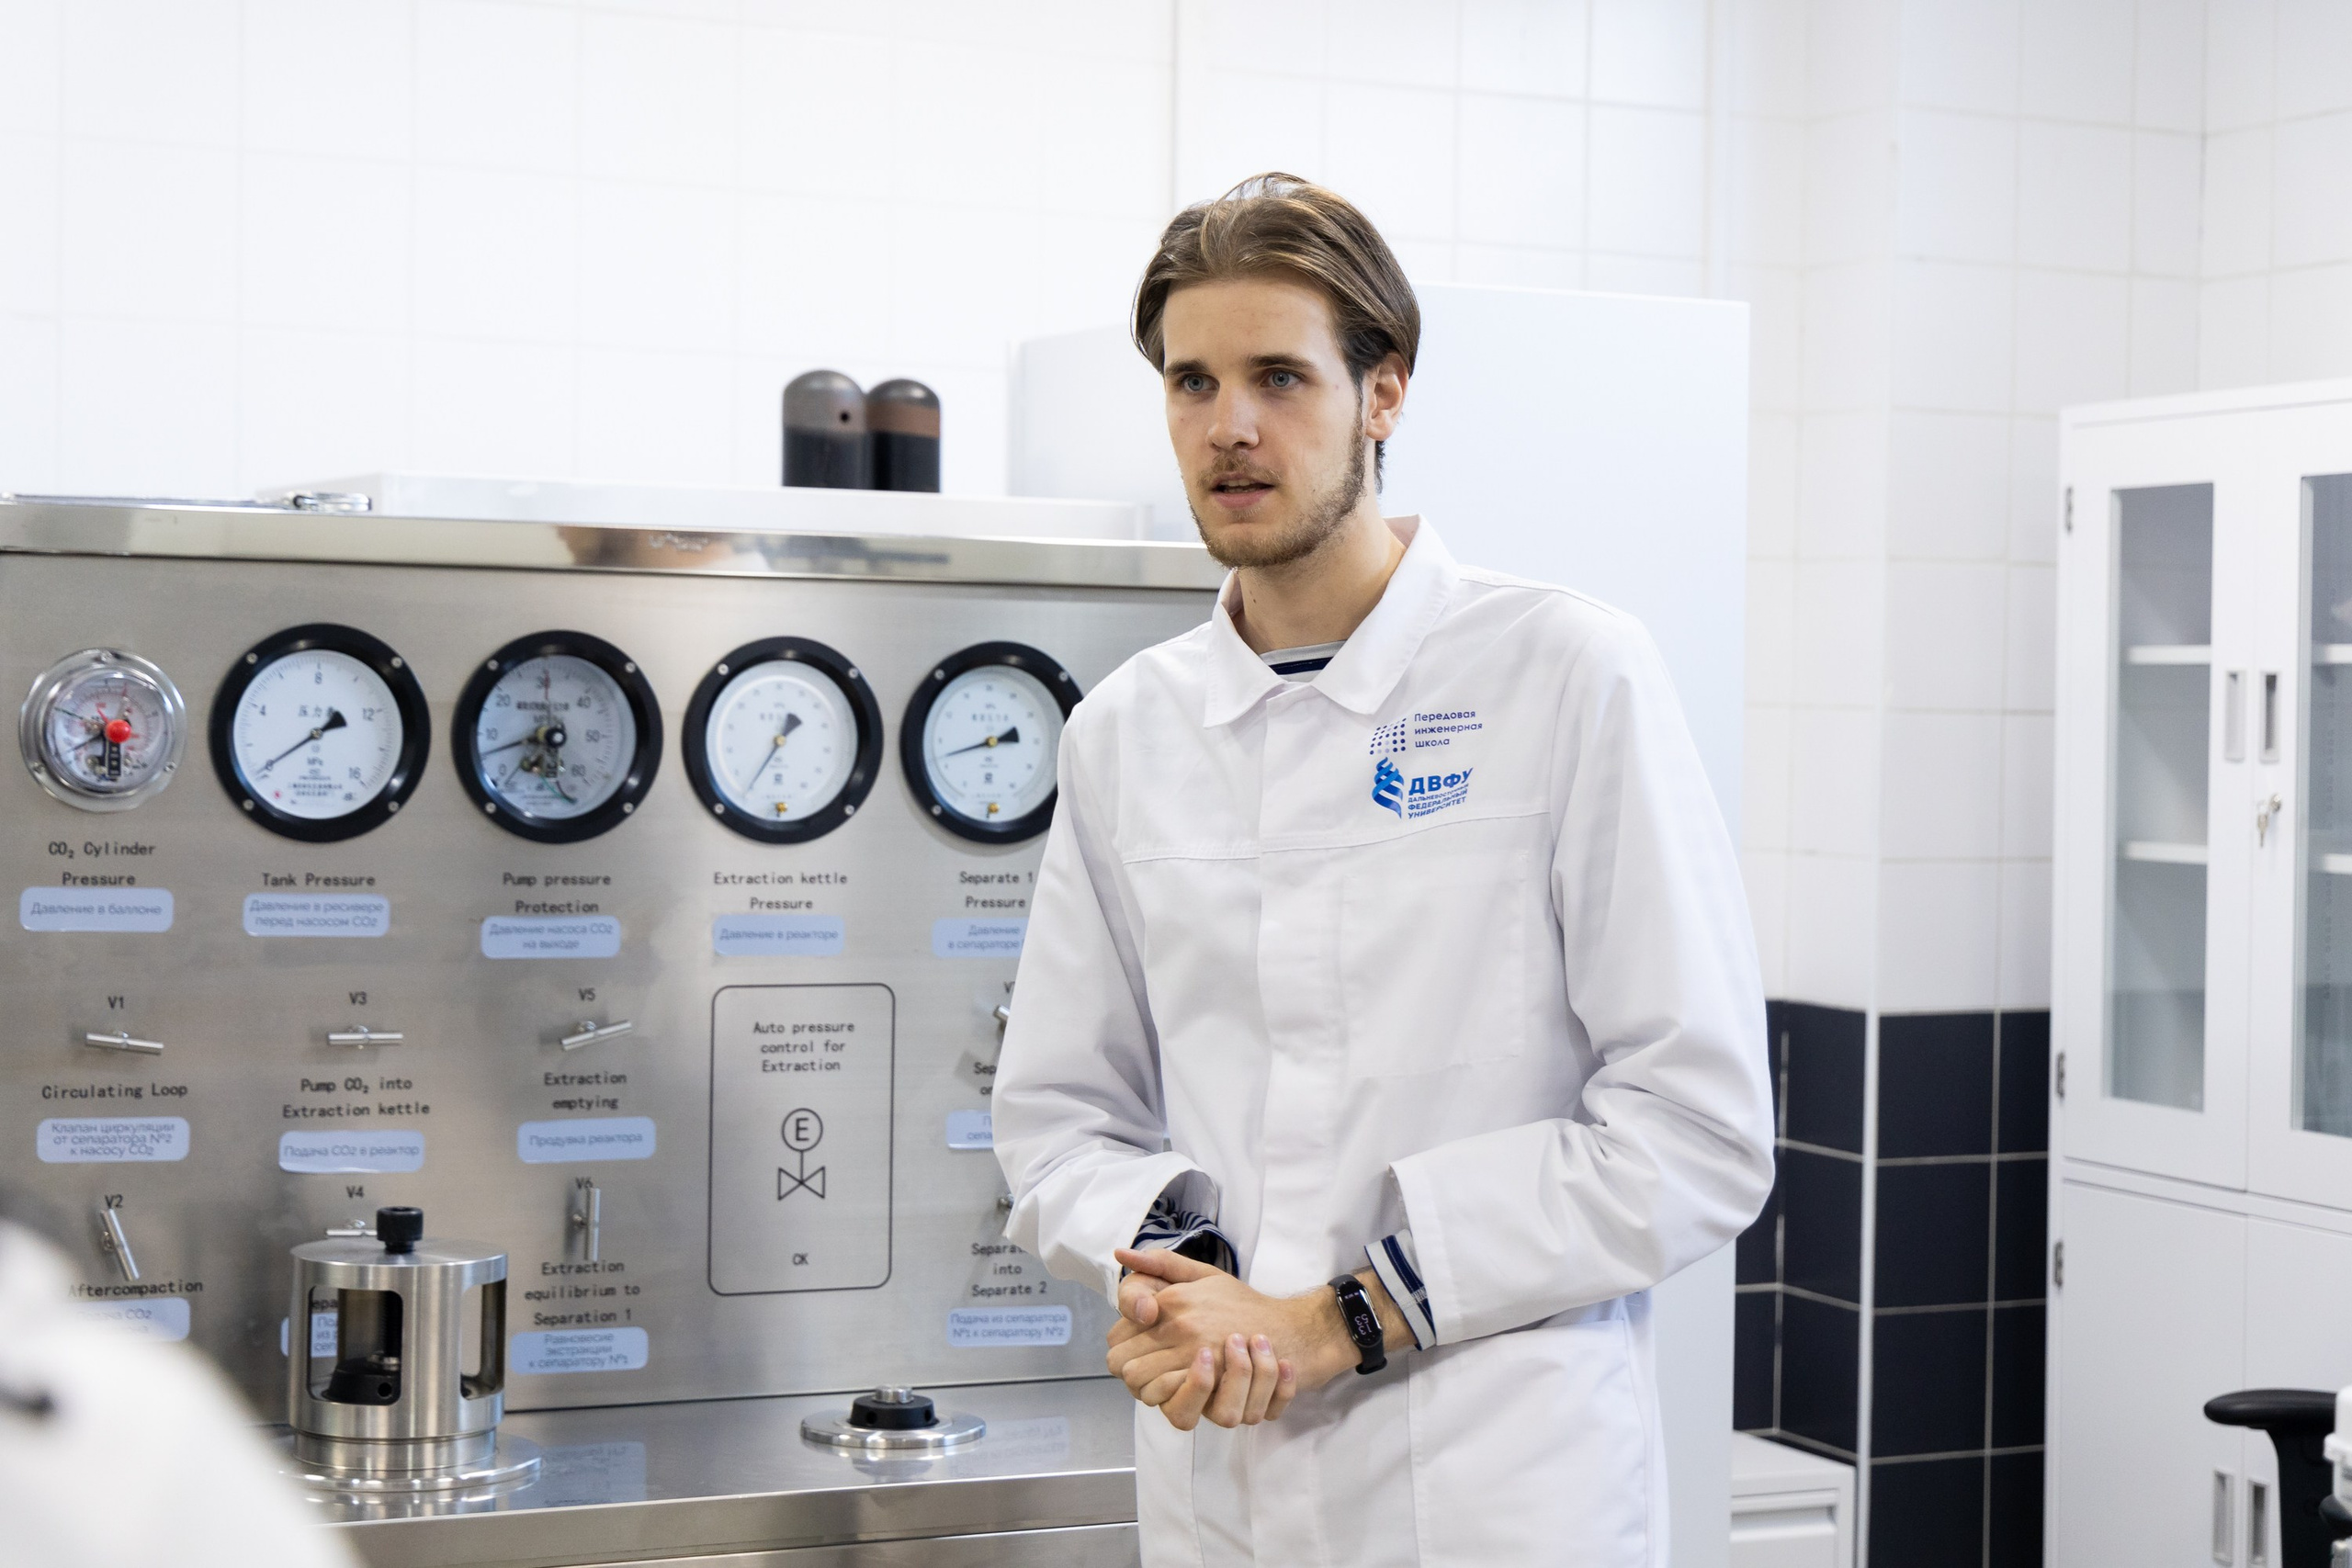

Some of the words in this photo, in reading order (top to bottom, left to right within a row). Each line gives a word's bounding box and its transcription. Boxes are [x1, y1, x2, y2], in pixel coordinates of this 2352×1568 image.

[1414, 711, 1476, 723] Передовая
[1414, 723, 1483, 735] инженерная
[1415, 739, 1450, 749] школа
[1408, 767, 1474, 795] ДВФУ
[1408, 789, 1468, 810] ФЕДЕРАЛЬНЫЙ
[1408, 796, 1466, 819] УНИВЕРСИТЕТ
[84, 841, 156, 858] Cylinder
[62, 872, 136, 886] Pressure
[262, 873, 298, 887] Tank
[305, 872, 376, 886] Pressure
[503, 873, 537, 887] Pump
[545, 875, 611, 887] pressure
[713, 872, 793, 885] Extraction
[801, 872, 848, 885] kettle
[959, 871, 1020, 885] Separate
[515, 899, 599, 913] Protection
[750, 897, 813, 909] Pressure
[965, 895, 1026, 908] Pressure
[30, 902, 95, 916] Давление
[348, 991, 367, 1006] V3
[578, 987, 595, 1001] V5
[107, 996, 125, 1010] V1
[753, 1021, 785, 1034] Auto
[792, 1021, 855, 1034] pressure
[761, 1041, 814, 1054] control
[823, 1039, 846, 1054] for
[762, 1059, 841, 1073] Extraction
[300, 1078, 336, 1093] Pump
[379, 1076, 413, 1090] into
[544, 1072, 628, 1087] Extraction
[41, 1084, 143, 1100] Circulating
[152, 1082, 188, 1098] Loop
[552, 1095, 619, 1110] emptying
[282, 1103, 370, 1119] Extraction
[378, 1101, 431, 1116] kettle
[51, 1123, 97, 1134] Клапан
[795, 1117, 810, 1143] E
[575, 1177, 593, 1190] V6
[346, 1186, 365, 1199] V4
[105, 1194, 123, 1209] V2
[541, 1260, 626, 1276] Extraction
[993, 1263, 1022, 1275] into
[525, 1285, 617, 1301] equilibrium
[625, 1285, 640, 1296] to
[972, 1283, 1032, 1297] Separate
[1038, 1280, 1047, 1294] 2
[534, 1310, 617, 1326] Separation
